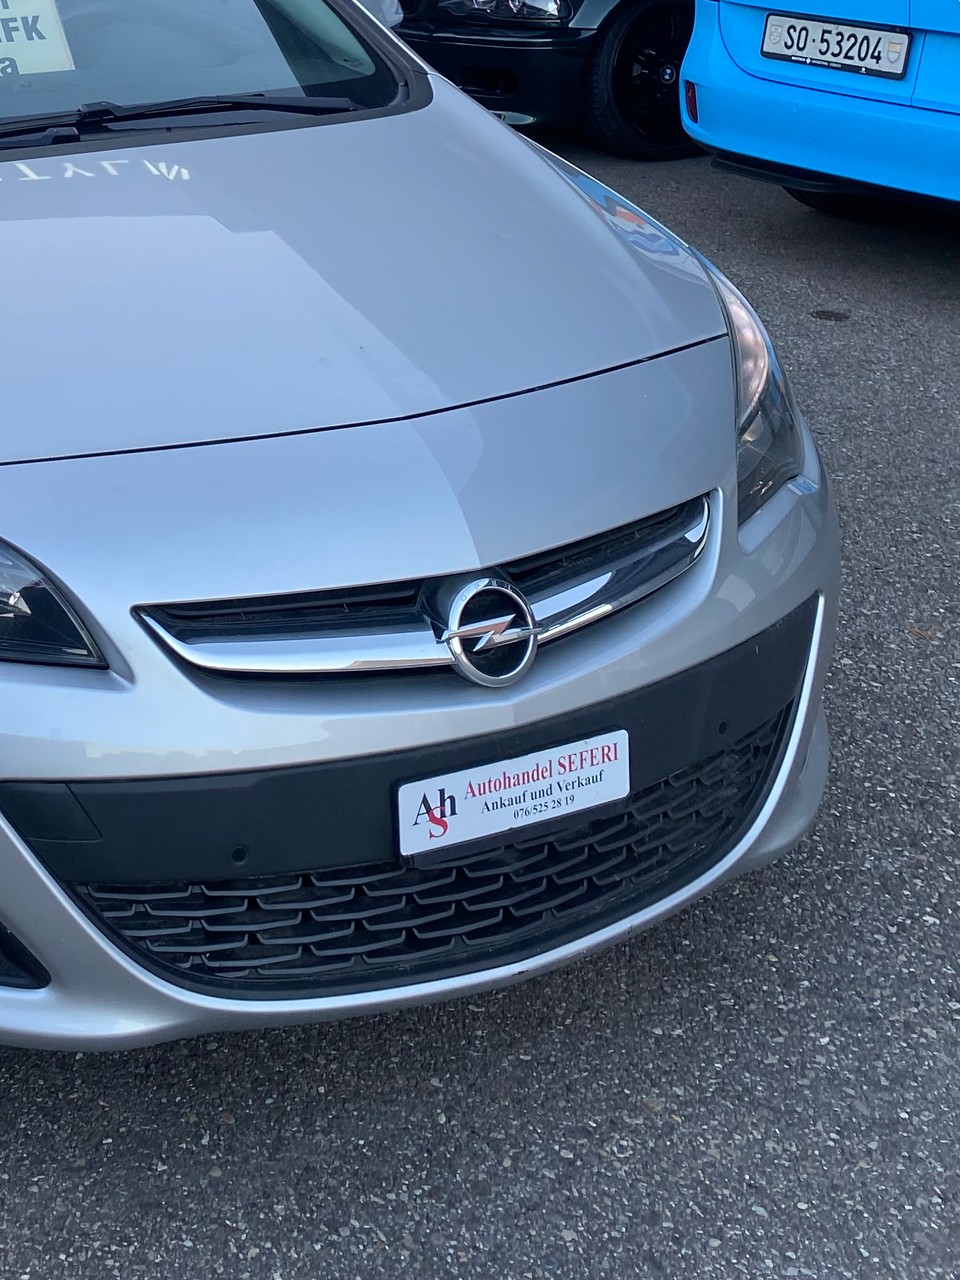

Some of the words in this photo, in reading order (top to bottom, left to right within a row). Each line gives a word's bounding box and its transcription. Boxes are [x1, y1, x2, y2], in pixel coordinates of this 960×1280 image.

[463, 758, 554, 800] Autohandel
[557, 741, 620, 777] SEFERI
[480, 790, 528, 814] Ankauf
[530, 783, 554, 802] und
[556, 769, 605, 794] Verkauf
[513, 800, 550, 820] 076/525
[551, 796, 563, 810] 28
[564, 793, 576, 807] 19
